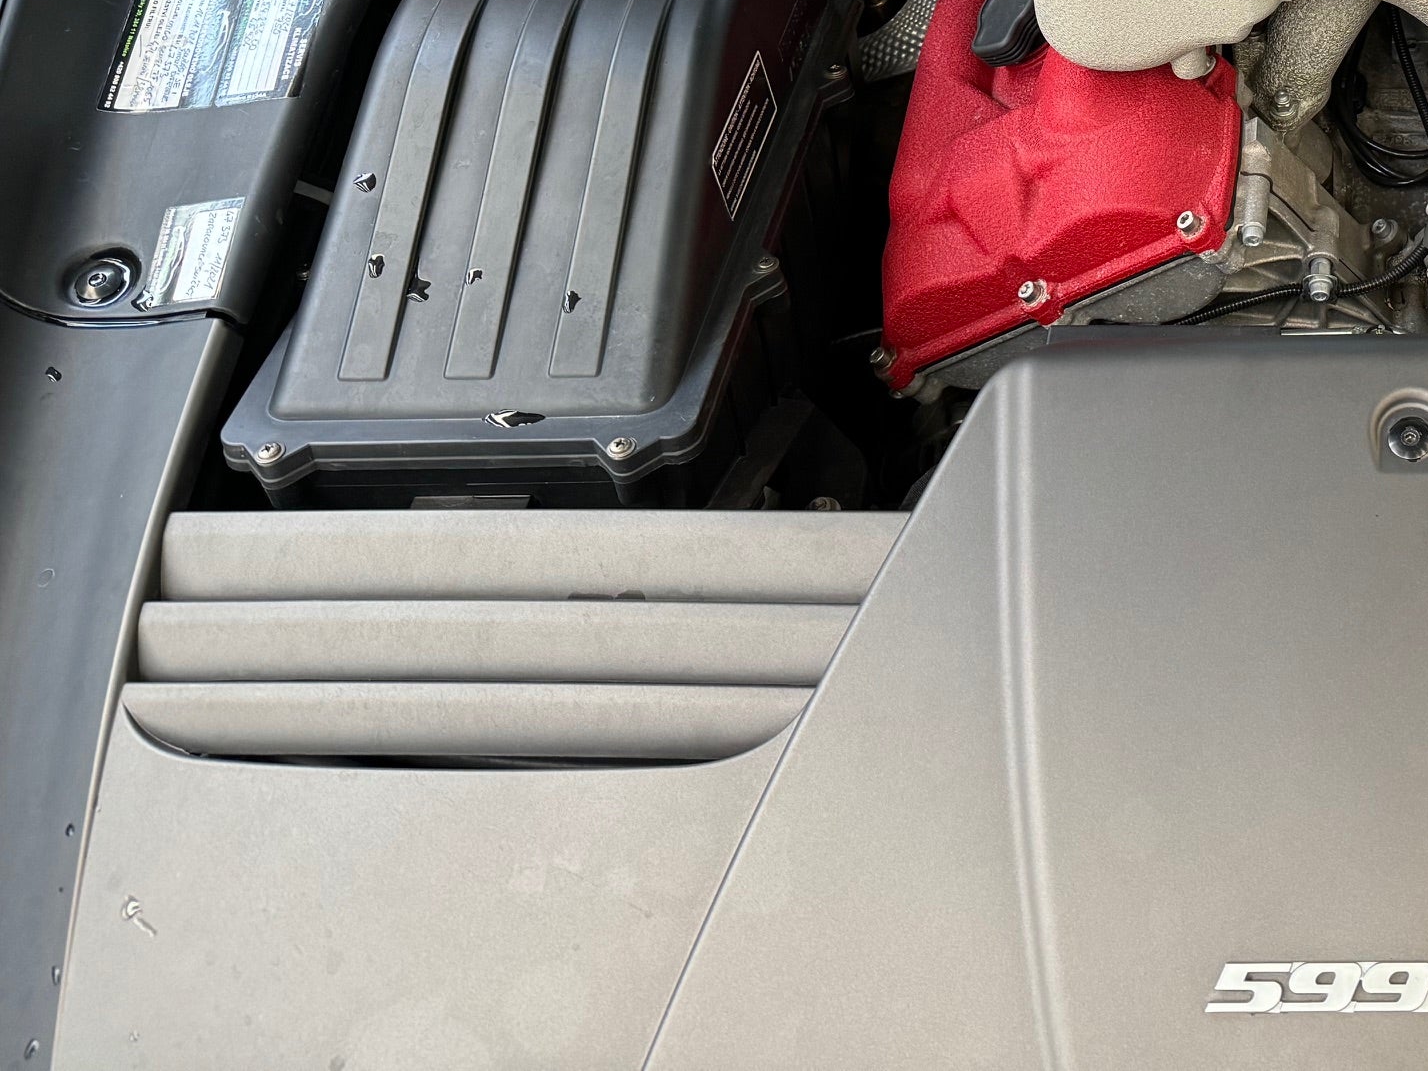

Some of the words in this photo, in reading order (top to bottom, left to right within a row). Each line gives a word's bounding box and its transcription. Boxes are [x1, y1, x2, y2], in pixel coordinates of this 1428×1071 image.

[144, 6, 157, 28] FILTRU:
[280, 27, 301, 80] KLIMATIZACE
[293, 38, 307, 66] SERVIS
